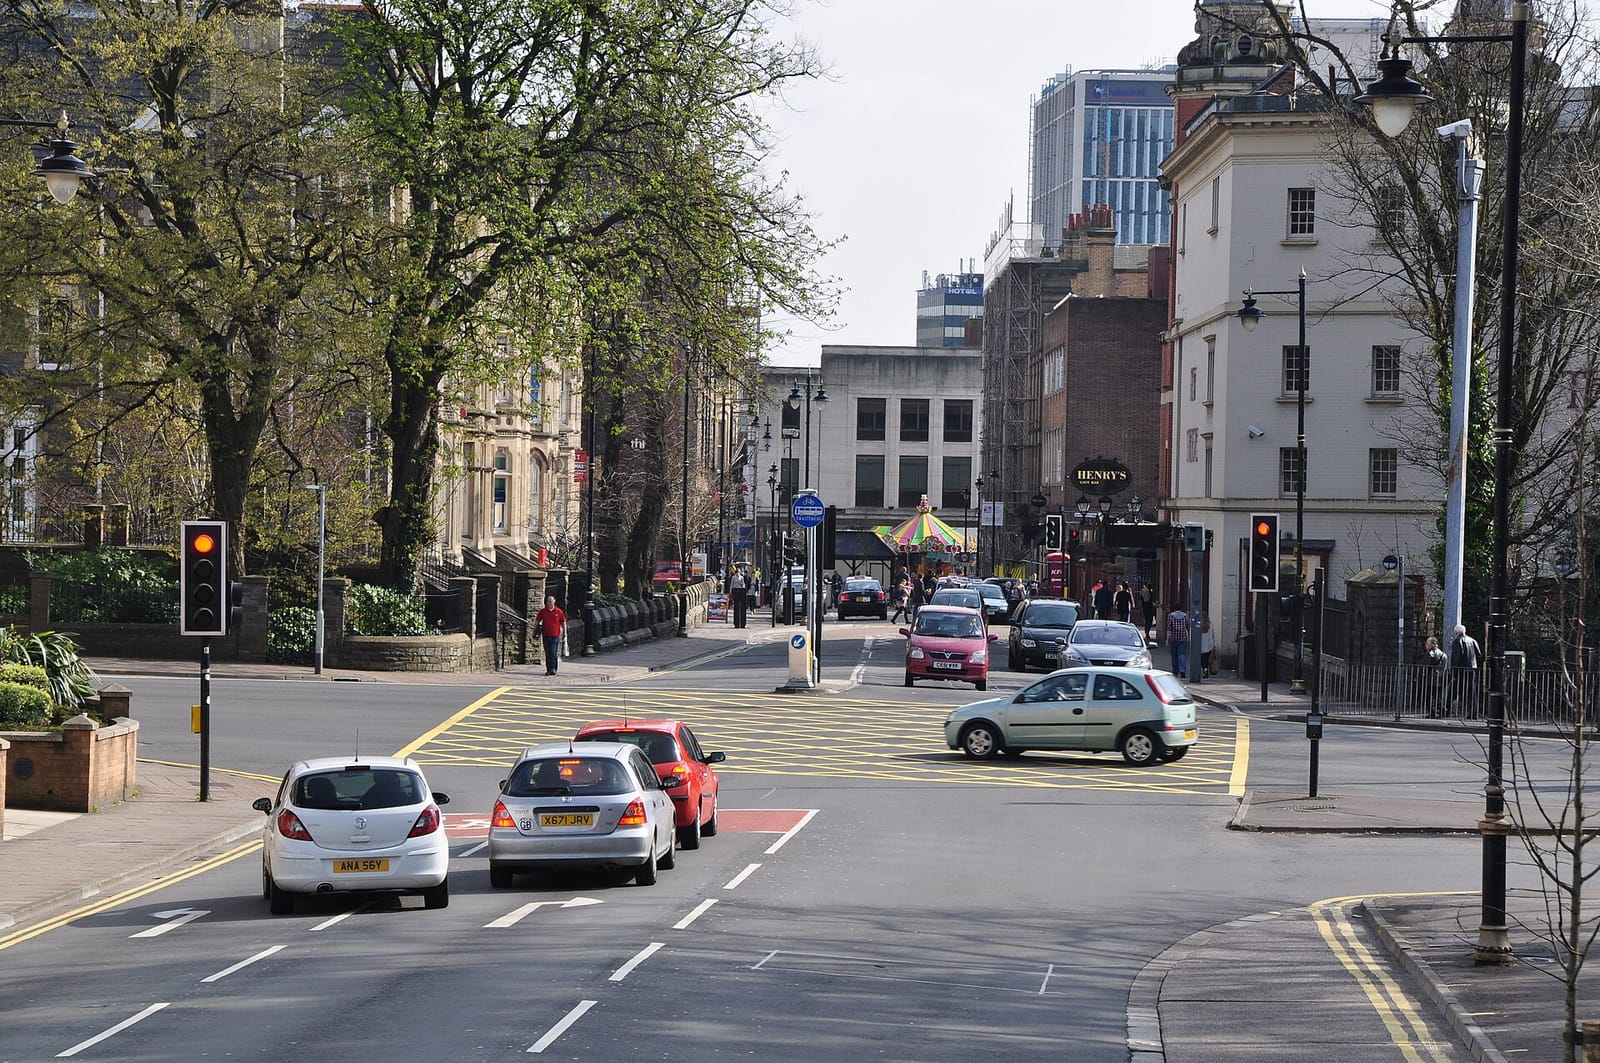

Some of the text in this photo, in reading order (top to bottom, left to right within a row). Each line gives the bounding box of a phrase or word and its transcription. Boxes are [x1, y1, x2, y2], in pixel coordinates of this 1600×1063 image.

[1077, 470, 1127, 480] HENRY'S
[520, 820, 532, 829] GB
[544, 815, 590, 825] X671 JRV
[340, 861, 382, 871] ANA 56Y
